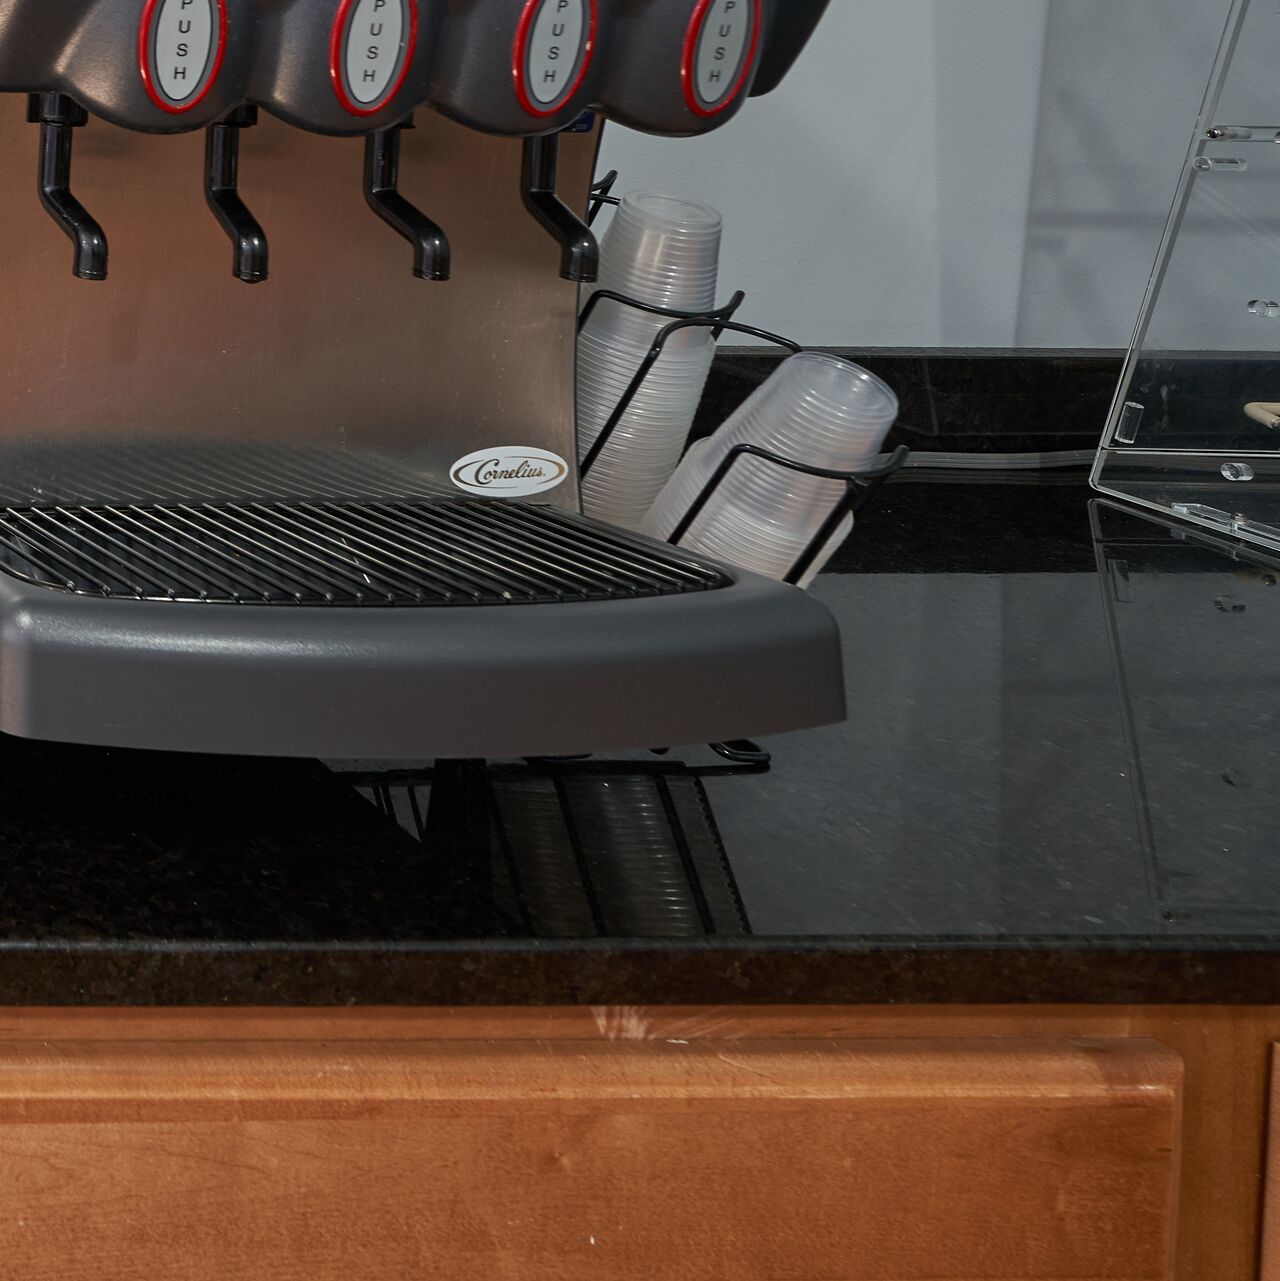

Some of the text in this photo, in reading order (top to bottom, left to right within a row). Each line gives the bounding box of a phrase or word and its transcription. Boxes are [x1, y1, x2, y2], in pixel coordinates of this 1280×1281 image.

[363, 0, 386, 82] PUSH
[543, 0, 569, 82] PUSH
[708, 1, 736, 82] PUSH
[475, 458, 543, 485] Cornelius
